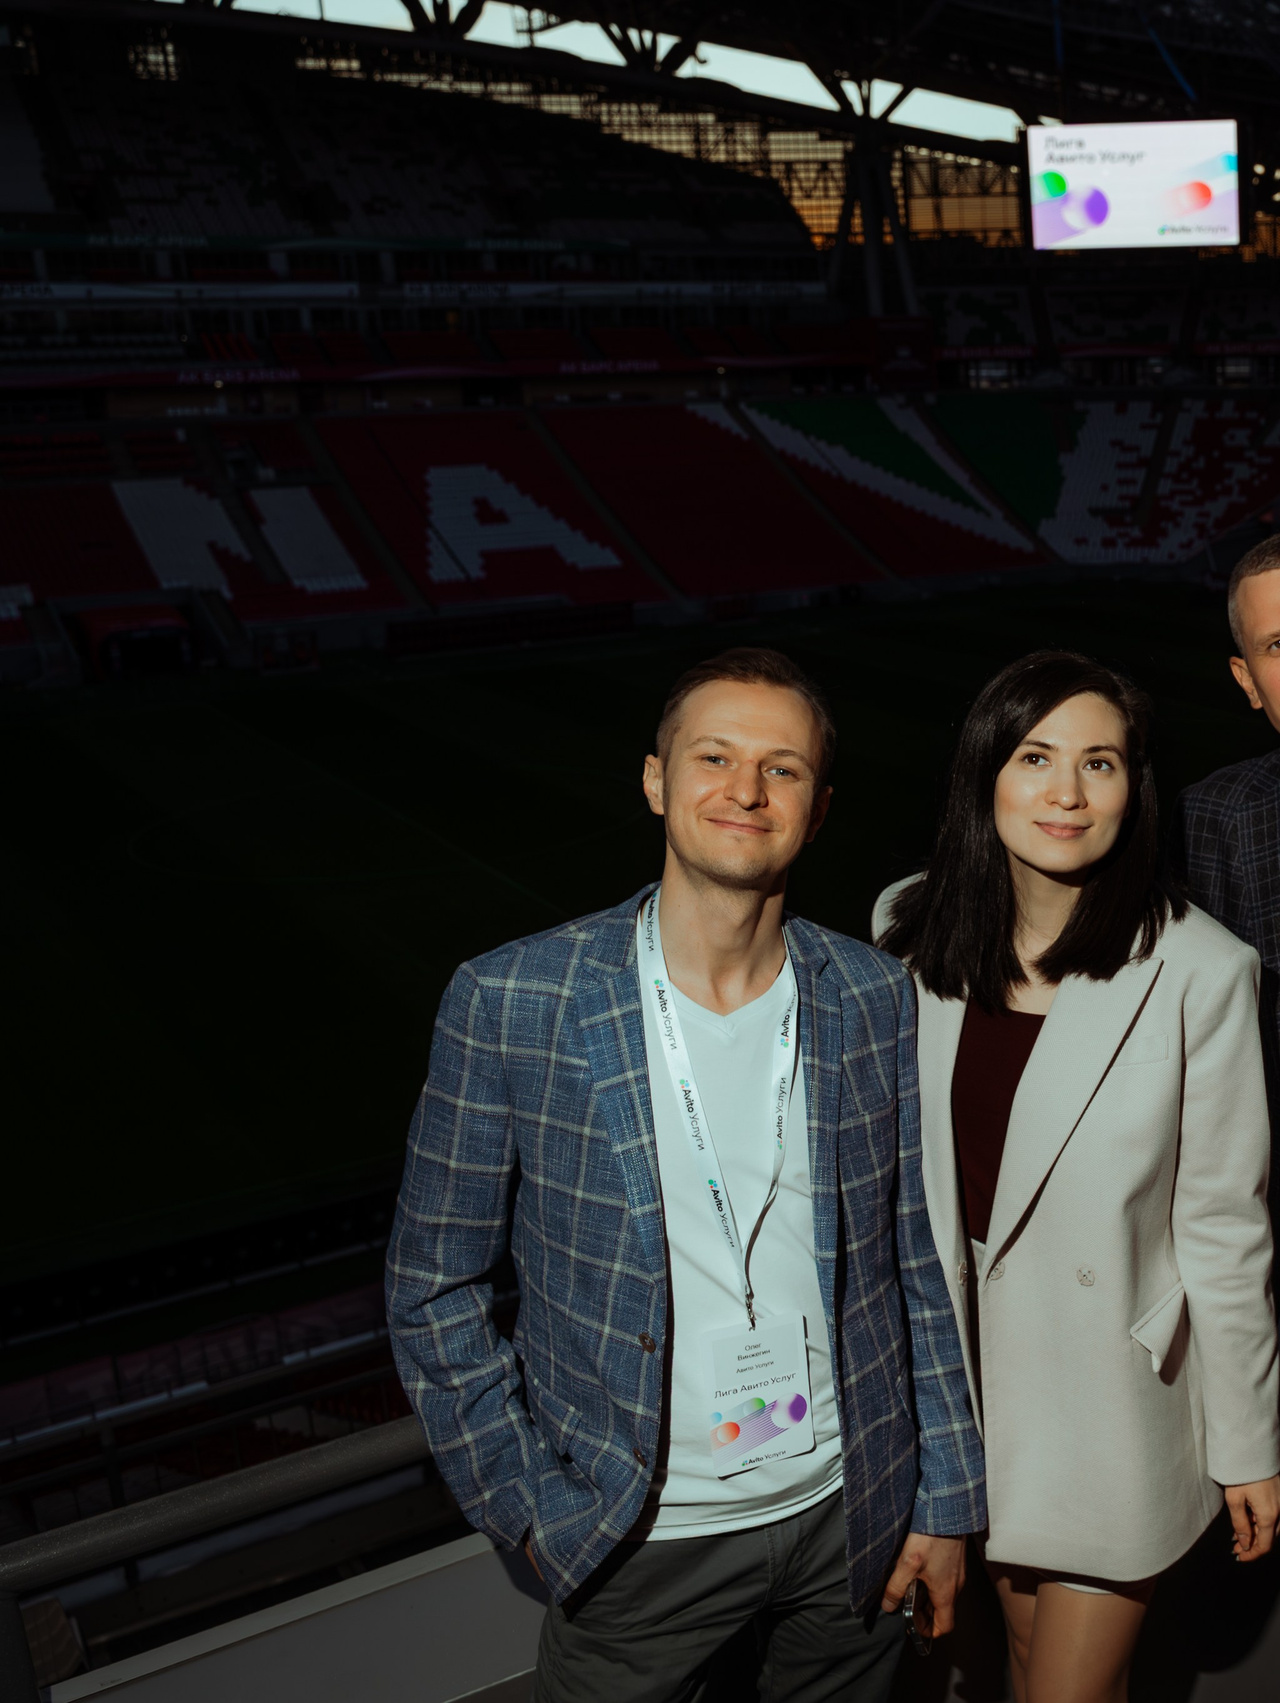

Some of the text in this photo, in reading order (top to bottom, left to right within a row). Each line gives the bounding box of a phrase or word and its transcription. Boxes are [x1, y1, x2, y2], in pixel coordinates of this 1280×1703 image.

[656, 988, 677, 1050] Avito Услуги
[780, 1014, 790, 1037] Avito
[775, 1077, 786, 1112] Услуги
[682, 1088, 704, 1150] Avito Услуги
[711, 1188, 734, 1247] Avito Услуги
[714, 1372, 796, 1398] Лига Авито Услуг
[748, 1450, 786, 1465] Avito Услуги
